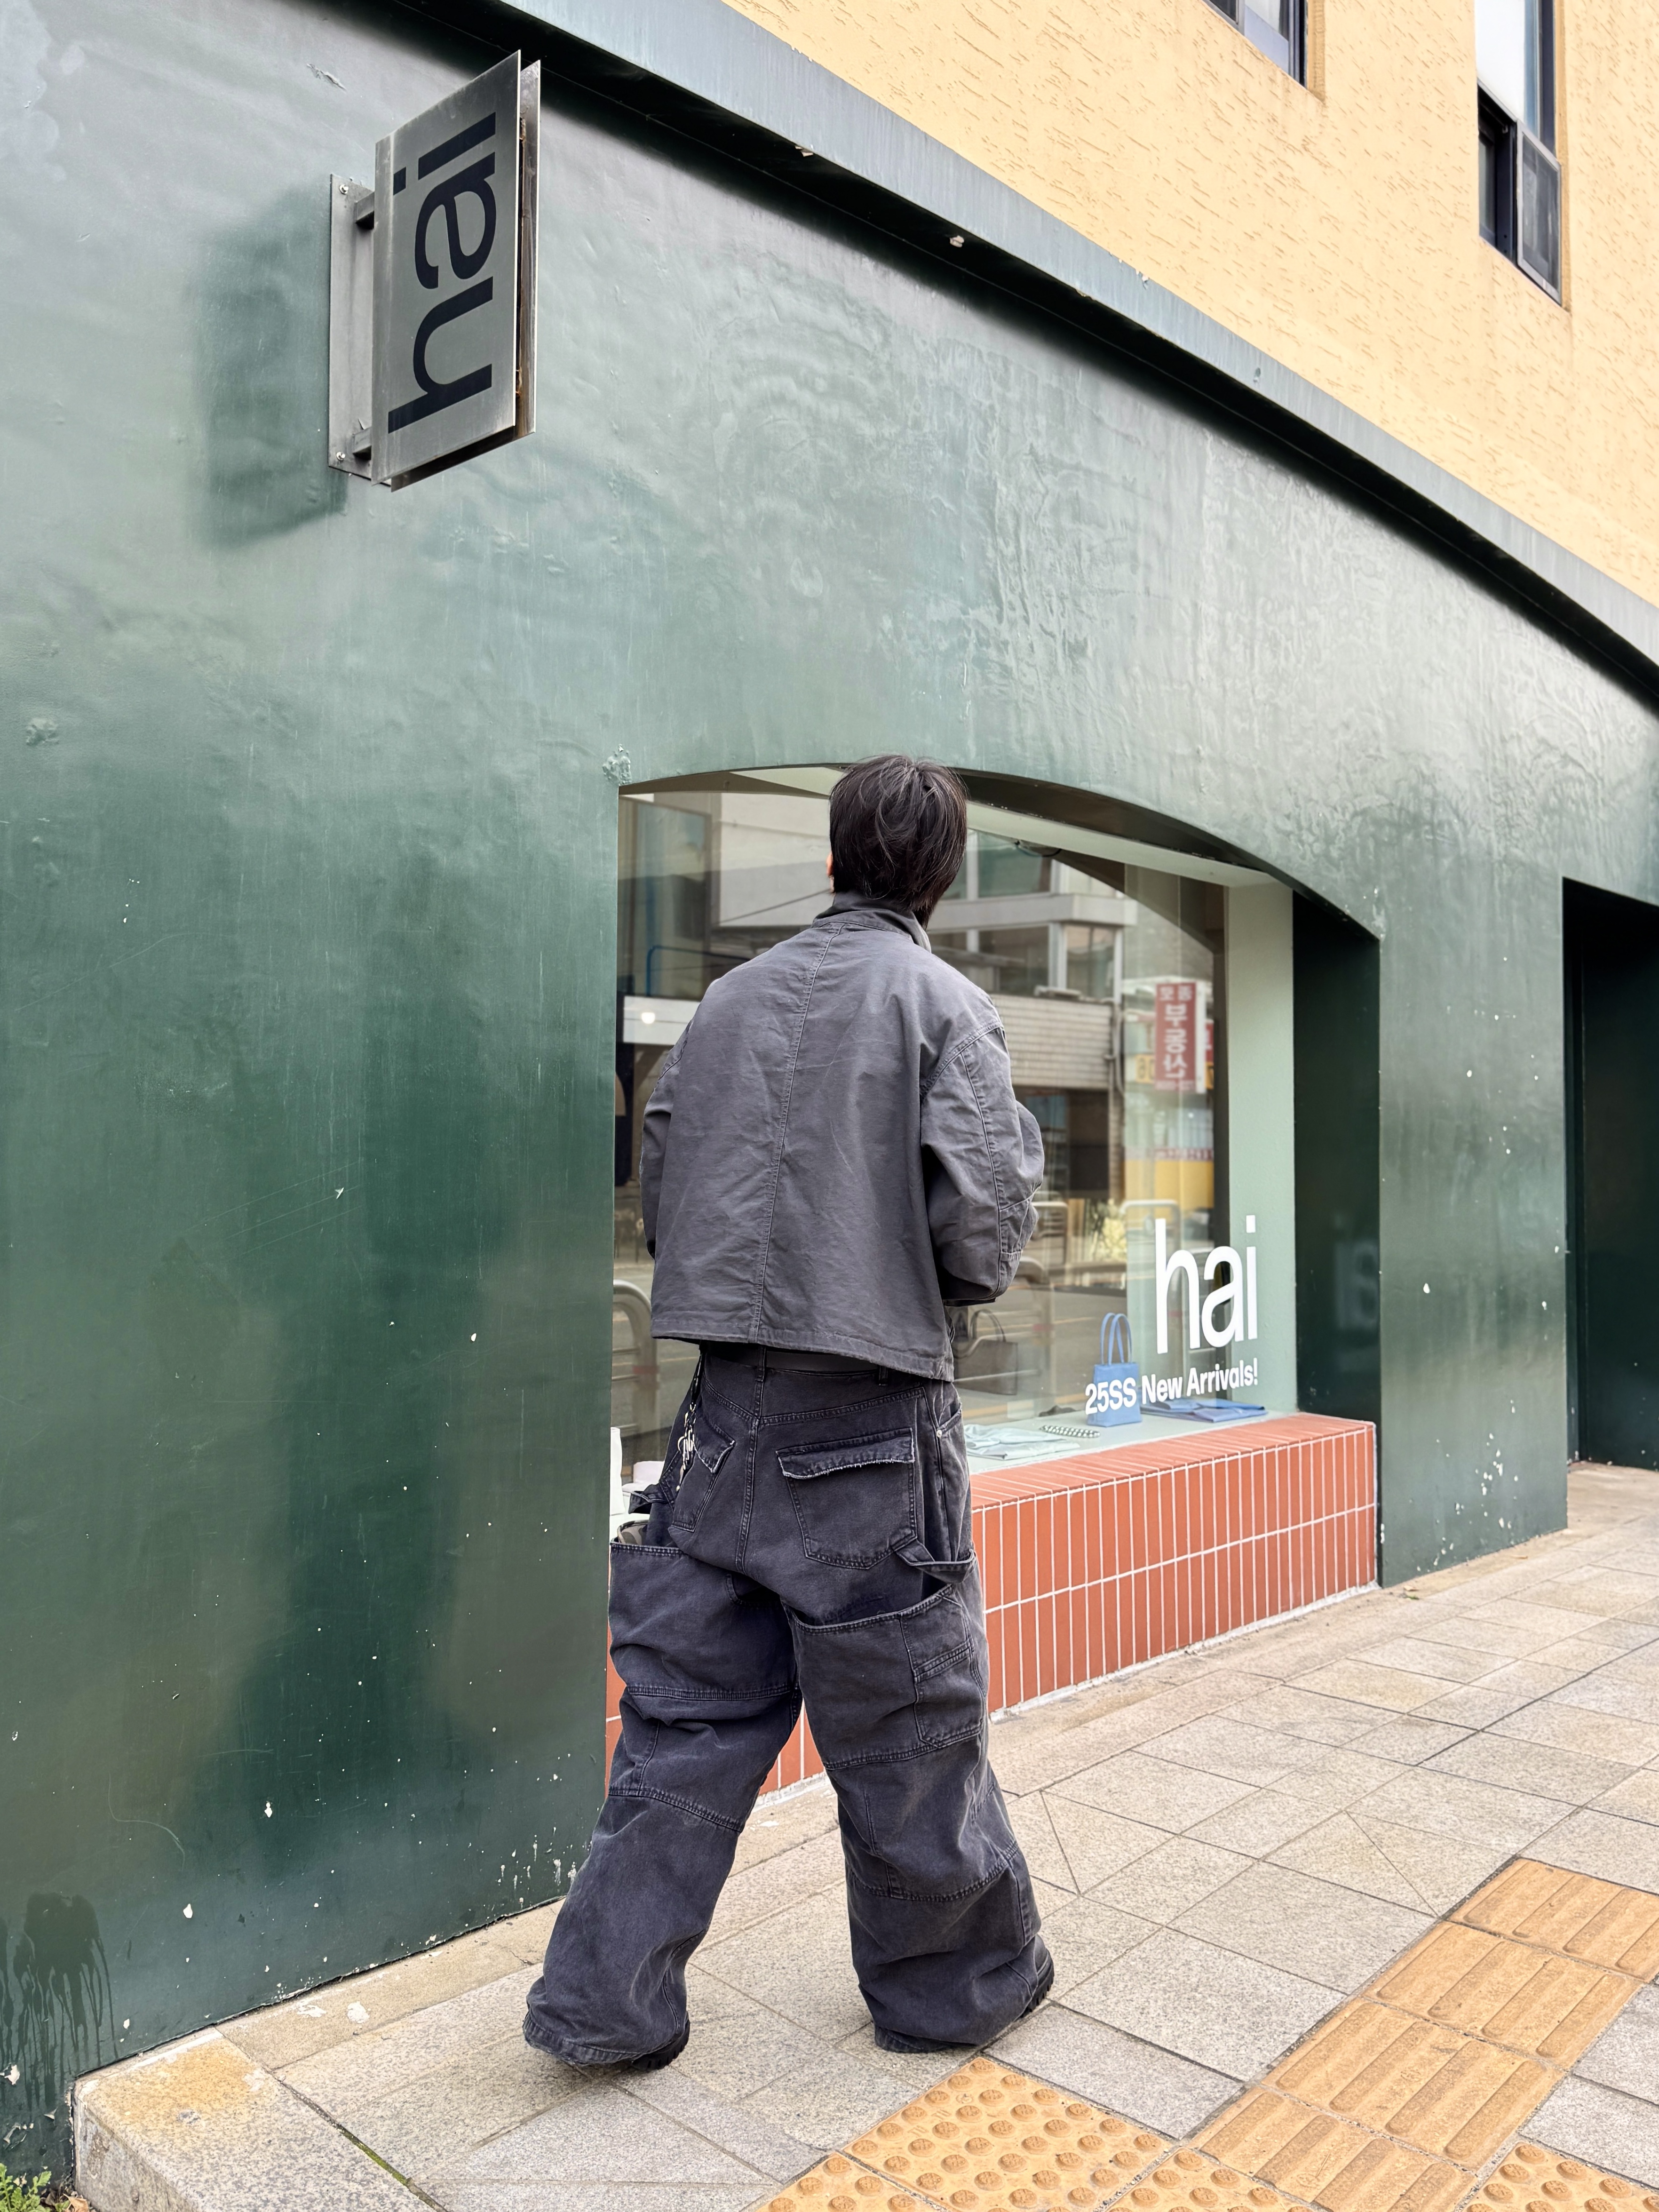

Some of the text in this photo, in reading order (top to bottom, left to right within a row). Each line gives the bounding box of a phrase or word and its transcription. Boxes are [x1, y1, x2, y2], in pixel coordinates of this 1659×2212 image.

[388, 111, 496, 434] hai
[1155, 1215, 1258, 1354] hai
[1085, 1357, 1258, 1415] 25SS New Arrivals!
